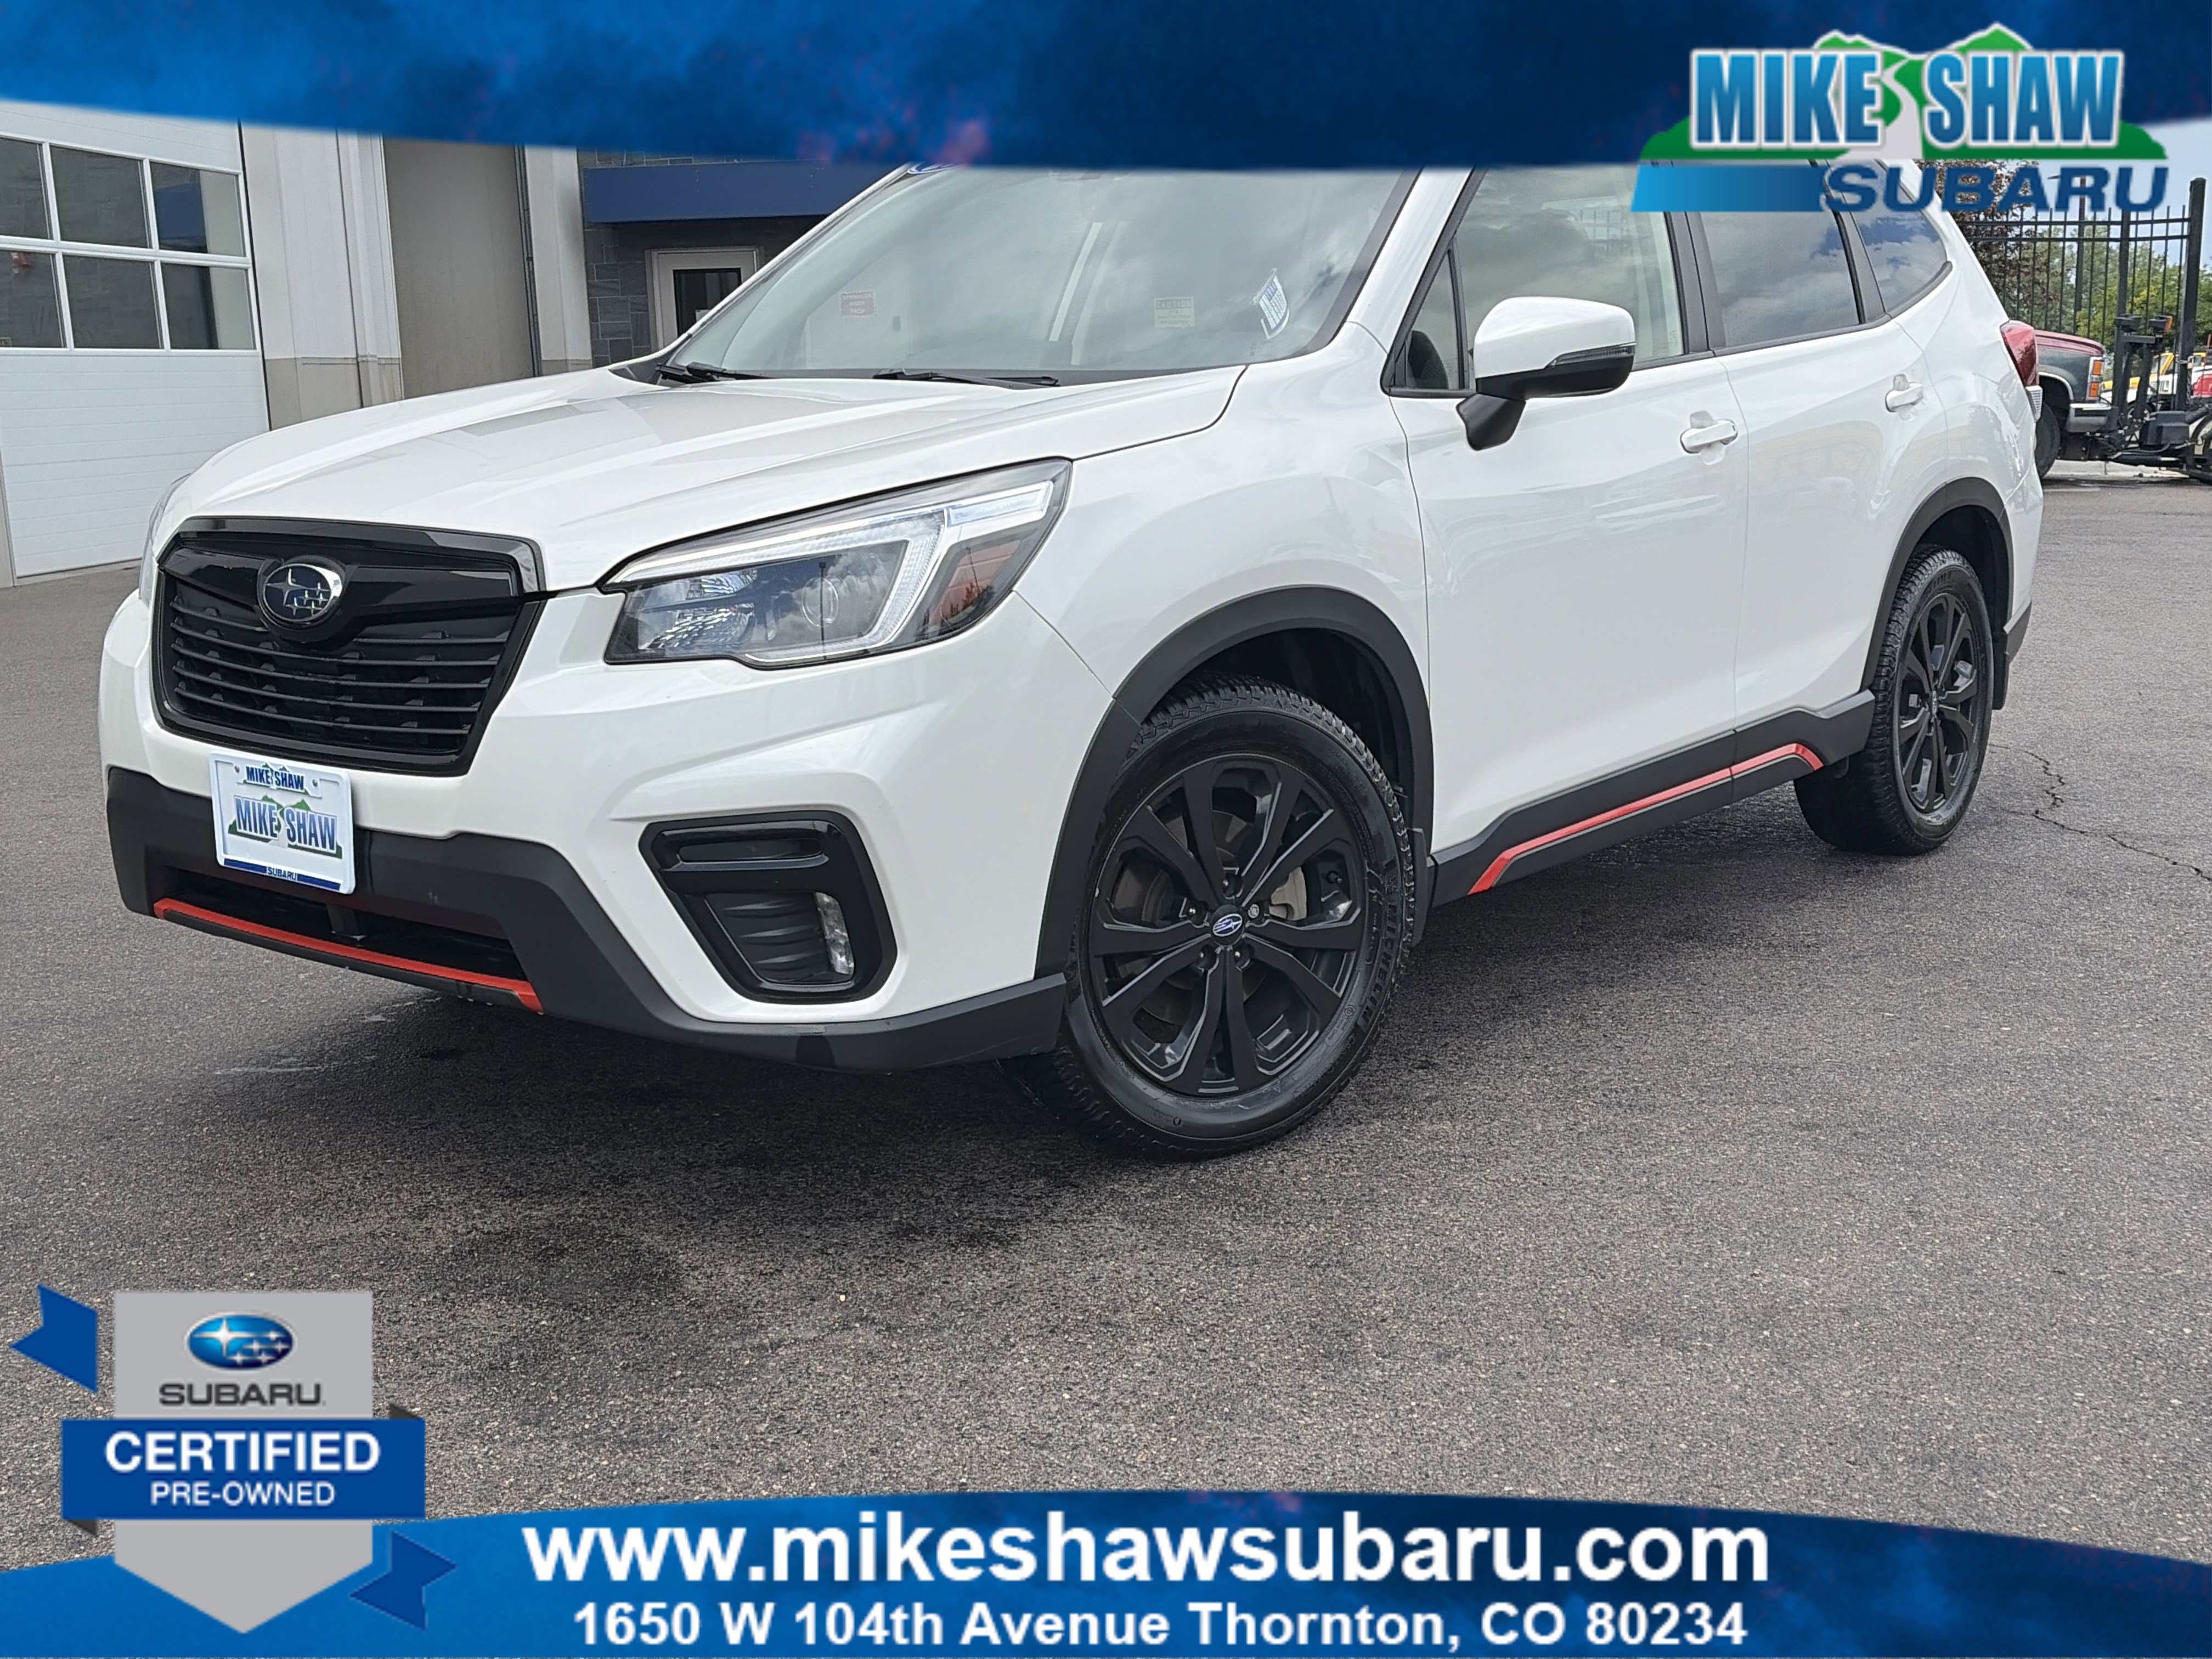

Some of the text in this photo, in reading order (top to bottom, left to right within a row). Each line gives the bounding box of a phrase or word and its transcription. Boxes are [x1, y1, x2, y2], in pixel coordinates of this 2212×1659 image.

[246, 766, 304, 790] MIKE SHAW
[235, 798, 336, 851] MIKE SHAW
[268, 867, 297, 881] SUBARU
[1361, 904, 1398, 1024] MICHELIN
